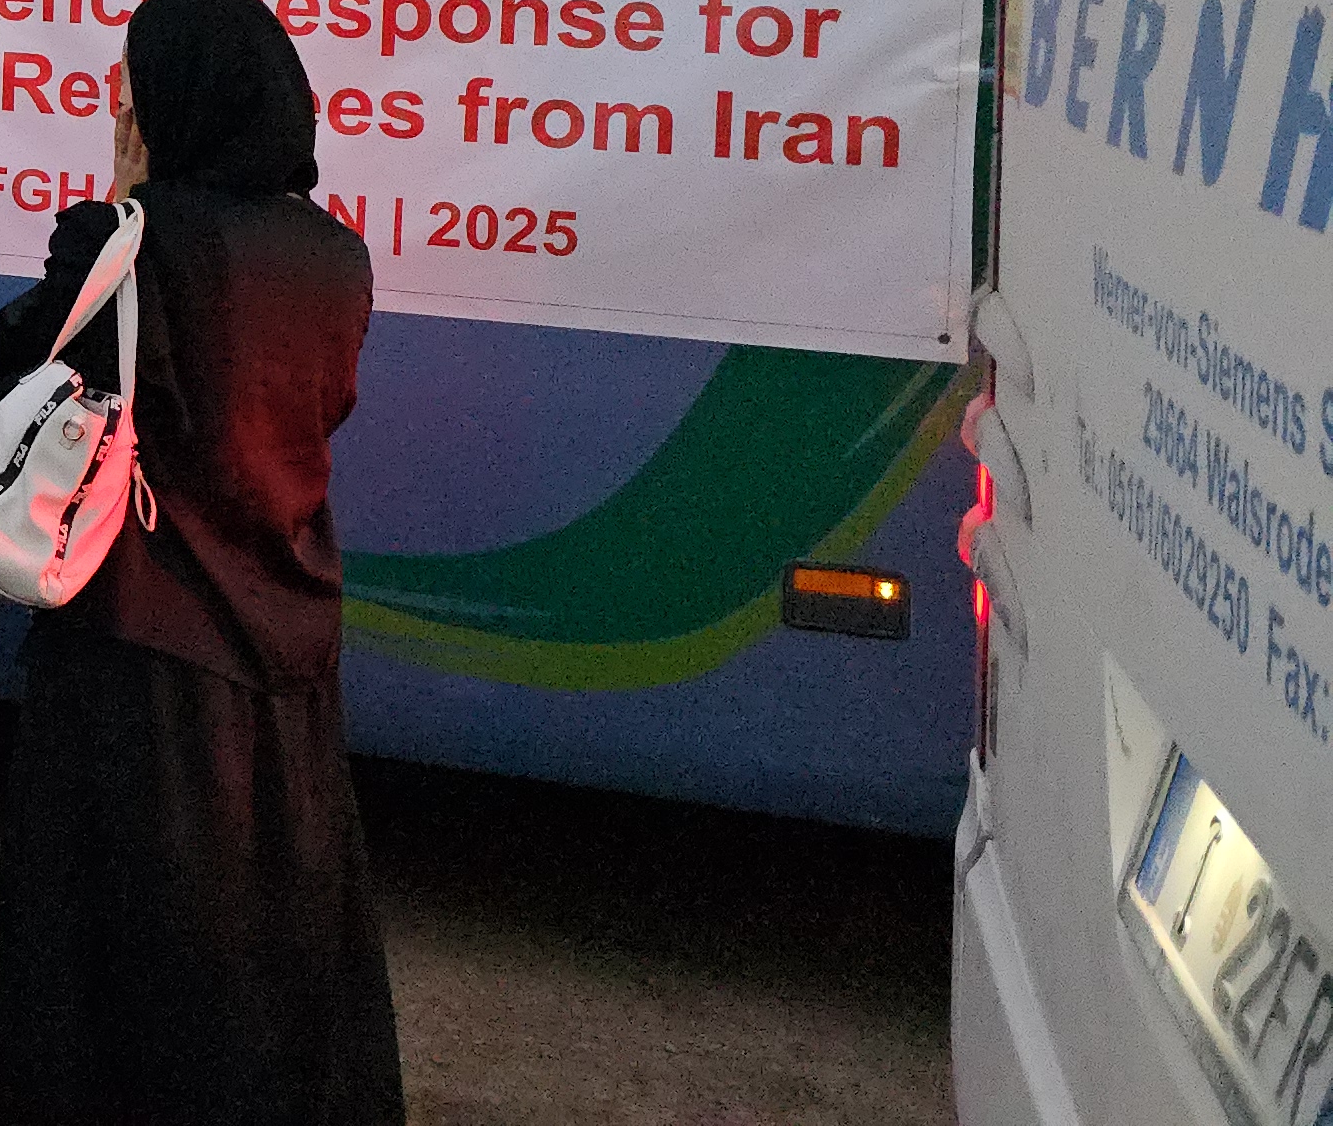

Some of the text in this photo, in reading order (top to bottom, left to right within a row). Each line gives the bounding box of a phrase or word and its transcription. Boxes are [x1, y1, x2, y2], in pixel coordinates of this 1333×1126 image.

[458, 77, 673, 155] from
[714, 91, 900, 168] Iran
[426, 201, 578, 256] 2025
[34, 400, 57, 425] FILA
[13, 443, 29, 468] FILA
[1205, 427, 1333, 607] Walsrode
[1266, 605, 1331, 742] Fax:
